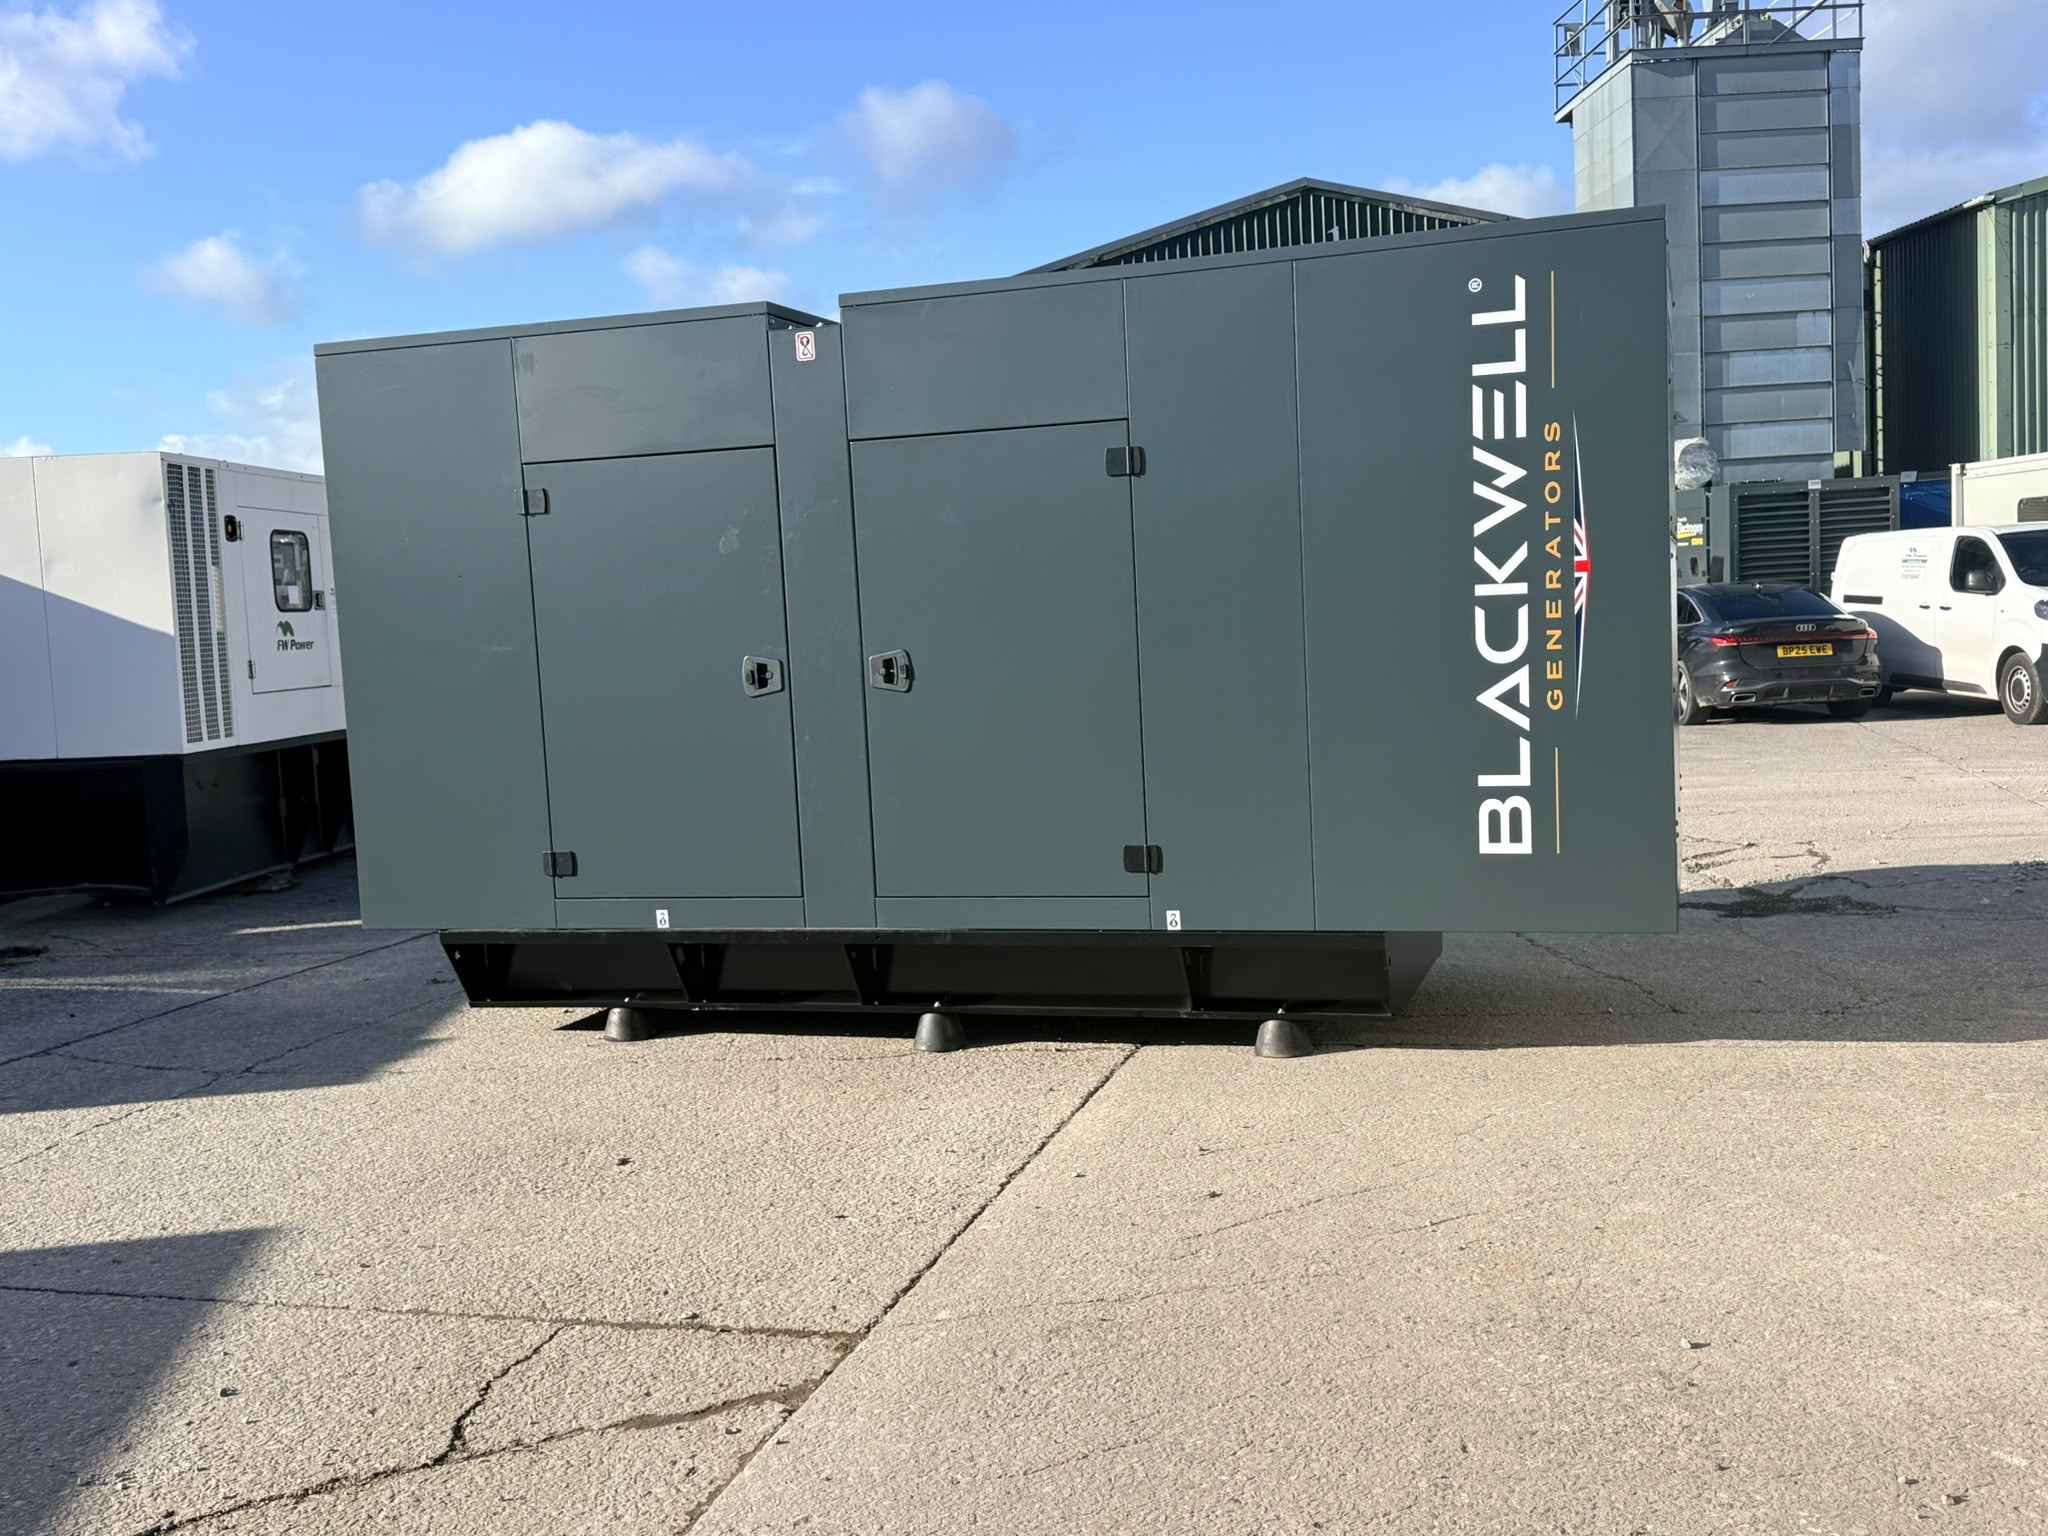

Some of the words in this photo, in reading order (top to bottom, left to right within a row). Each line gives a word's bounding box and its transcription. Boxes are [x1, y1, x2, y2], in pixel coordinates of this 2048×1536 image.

[1544, 422, 1564, 711] GENERATORS
[277, 639, 289, 651] FW
[290, 639, 314, 650] Power
[1782, 646, 1808, 656] BP25
[1809, 645, 1828, 655] EWE
